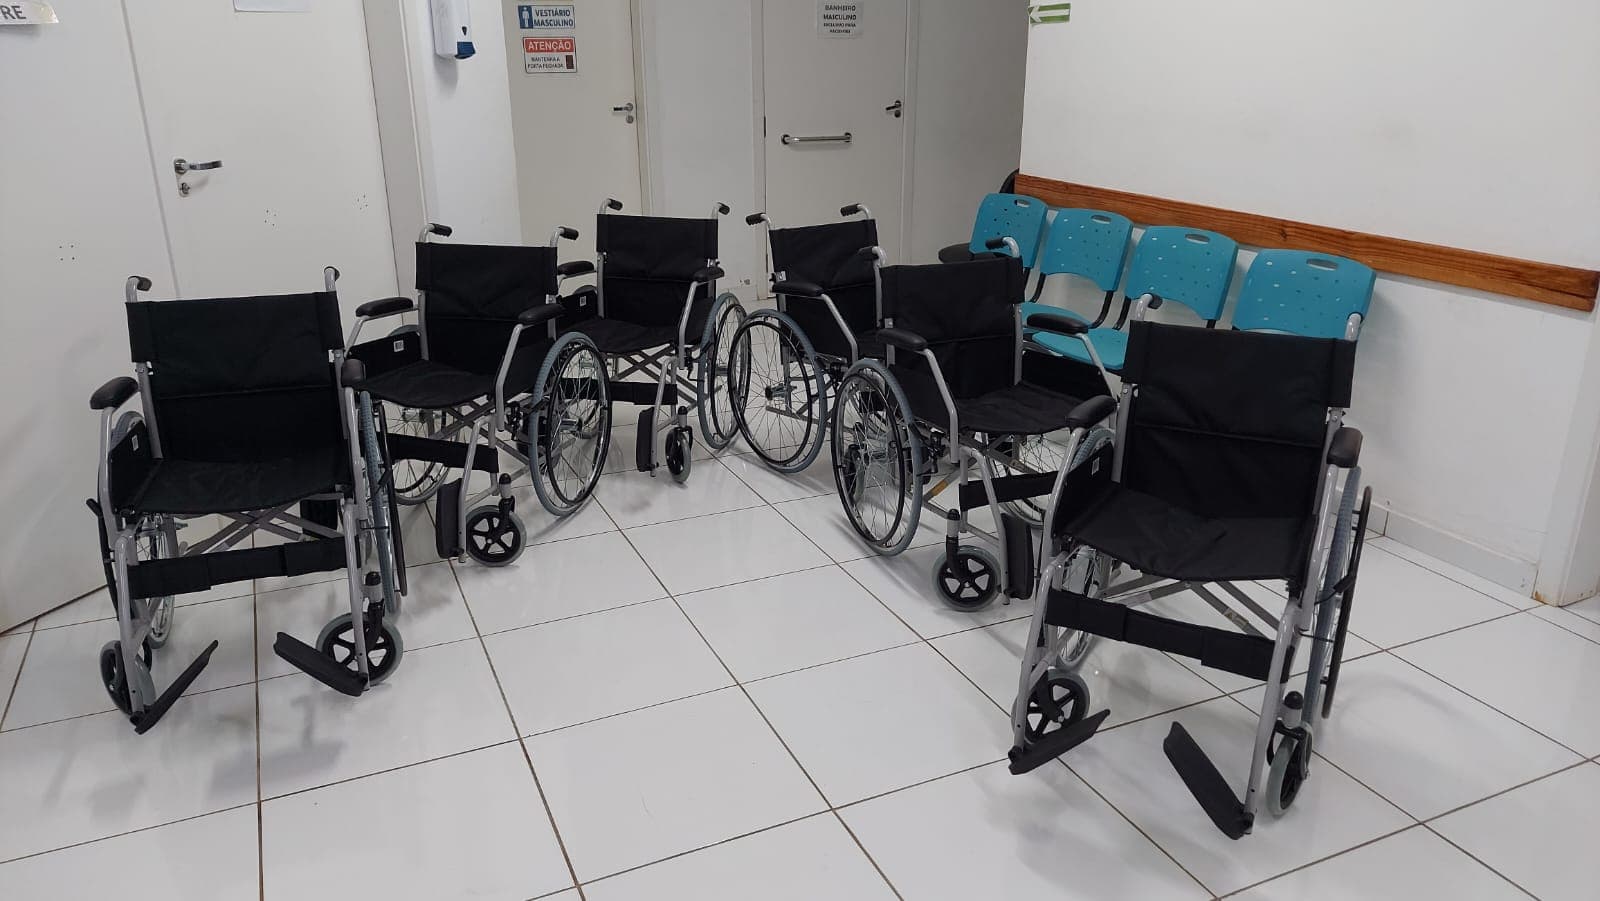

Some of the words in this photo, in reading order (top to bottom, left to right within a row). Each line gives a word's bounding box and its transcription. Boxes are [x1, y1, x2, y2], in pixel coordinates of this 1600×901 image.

[535, 8, 570, 16] VESTIÁRIO
[533, 19, 574, 27] MASCULINO
[528, 40, 571, 51] ATENÇÃO
